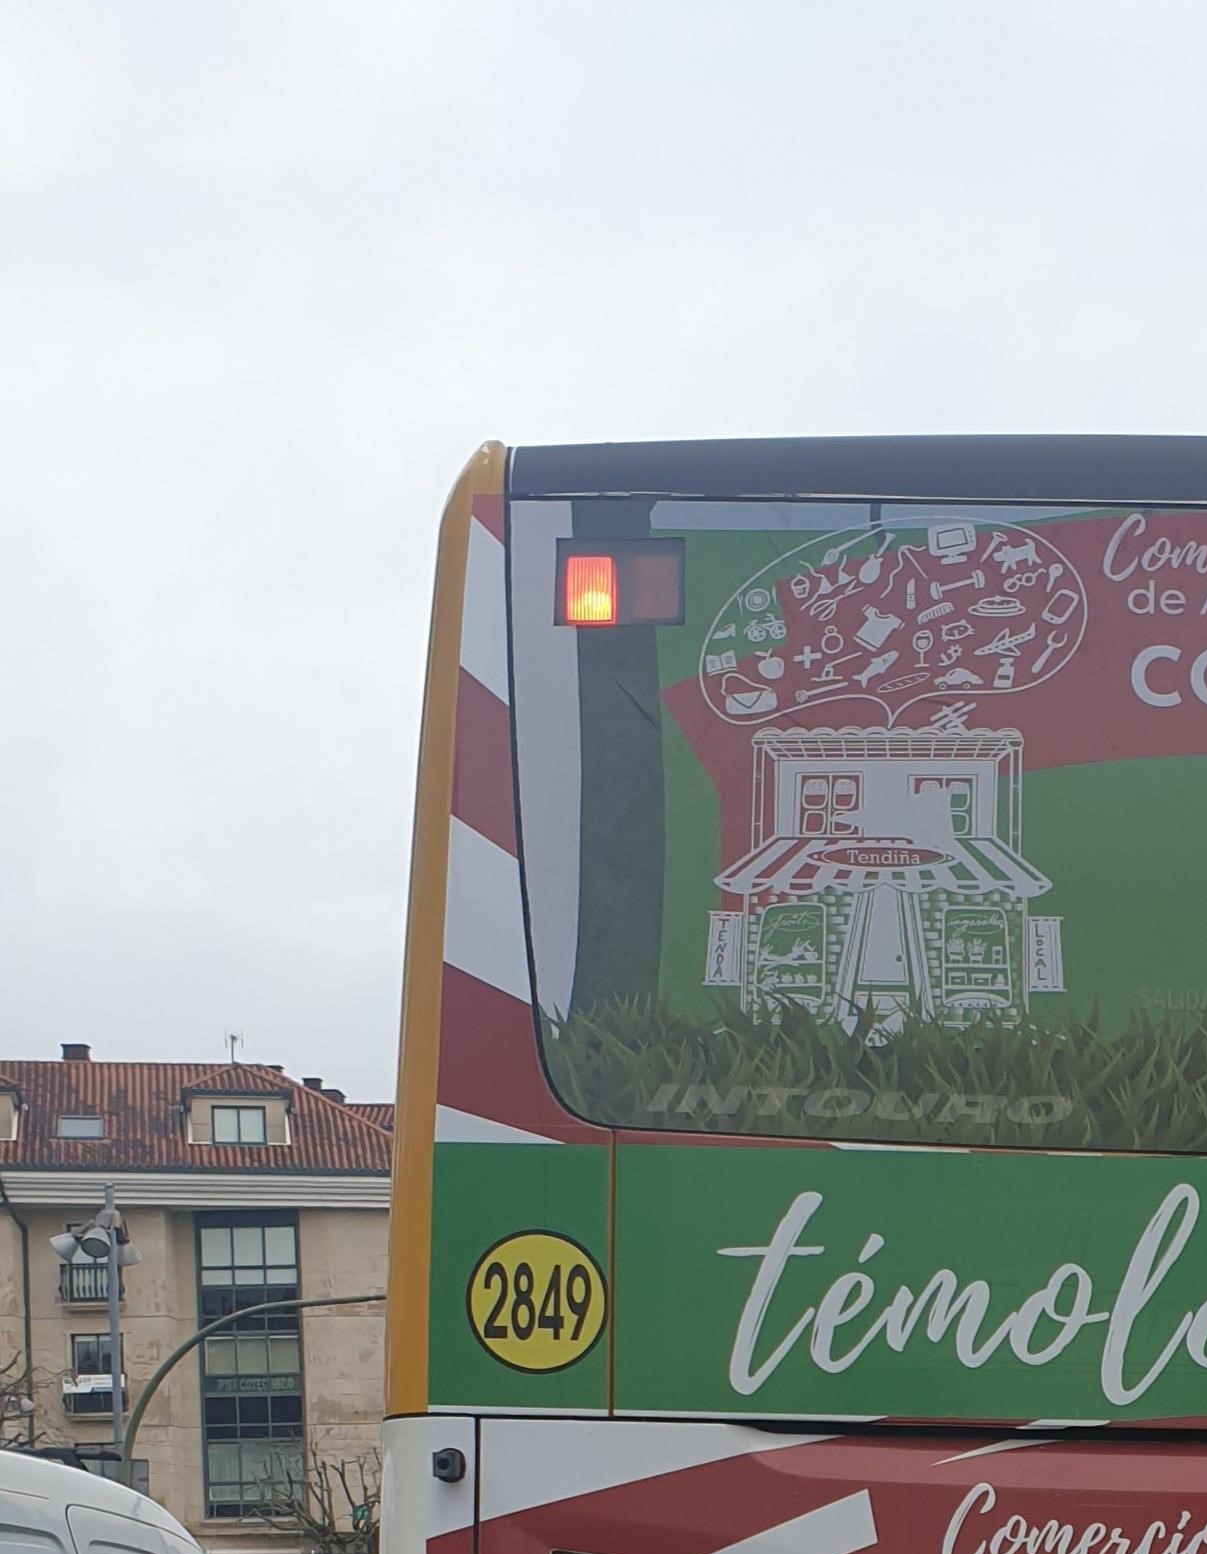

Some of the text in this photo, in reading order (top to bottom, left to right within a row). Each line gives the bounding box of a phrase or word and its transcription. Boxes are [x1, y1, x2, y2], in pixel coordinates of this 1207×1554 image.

[1127, 580, 1187, 615] de
[846, 849, 921, 866] Tendiña
[713, 918, 731, 978] TENDA
[647, 1083, 1075, 1124] INTOURO
[484, 1261, 592, 1341] 2849
